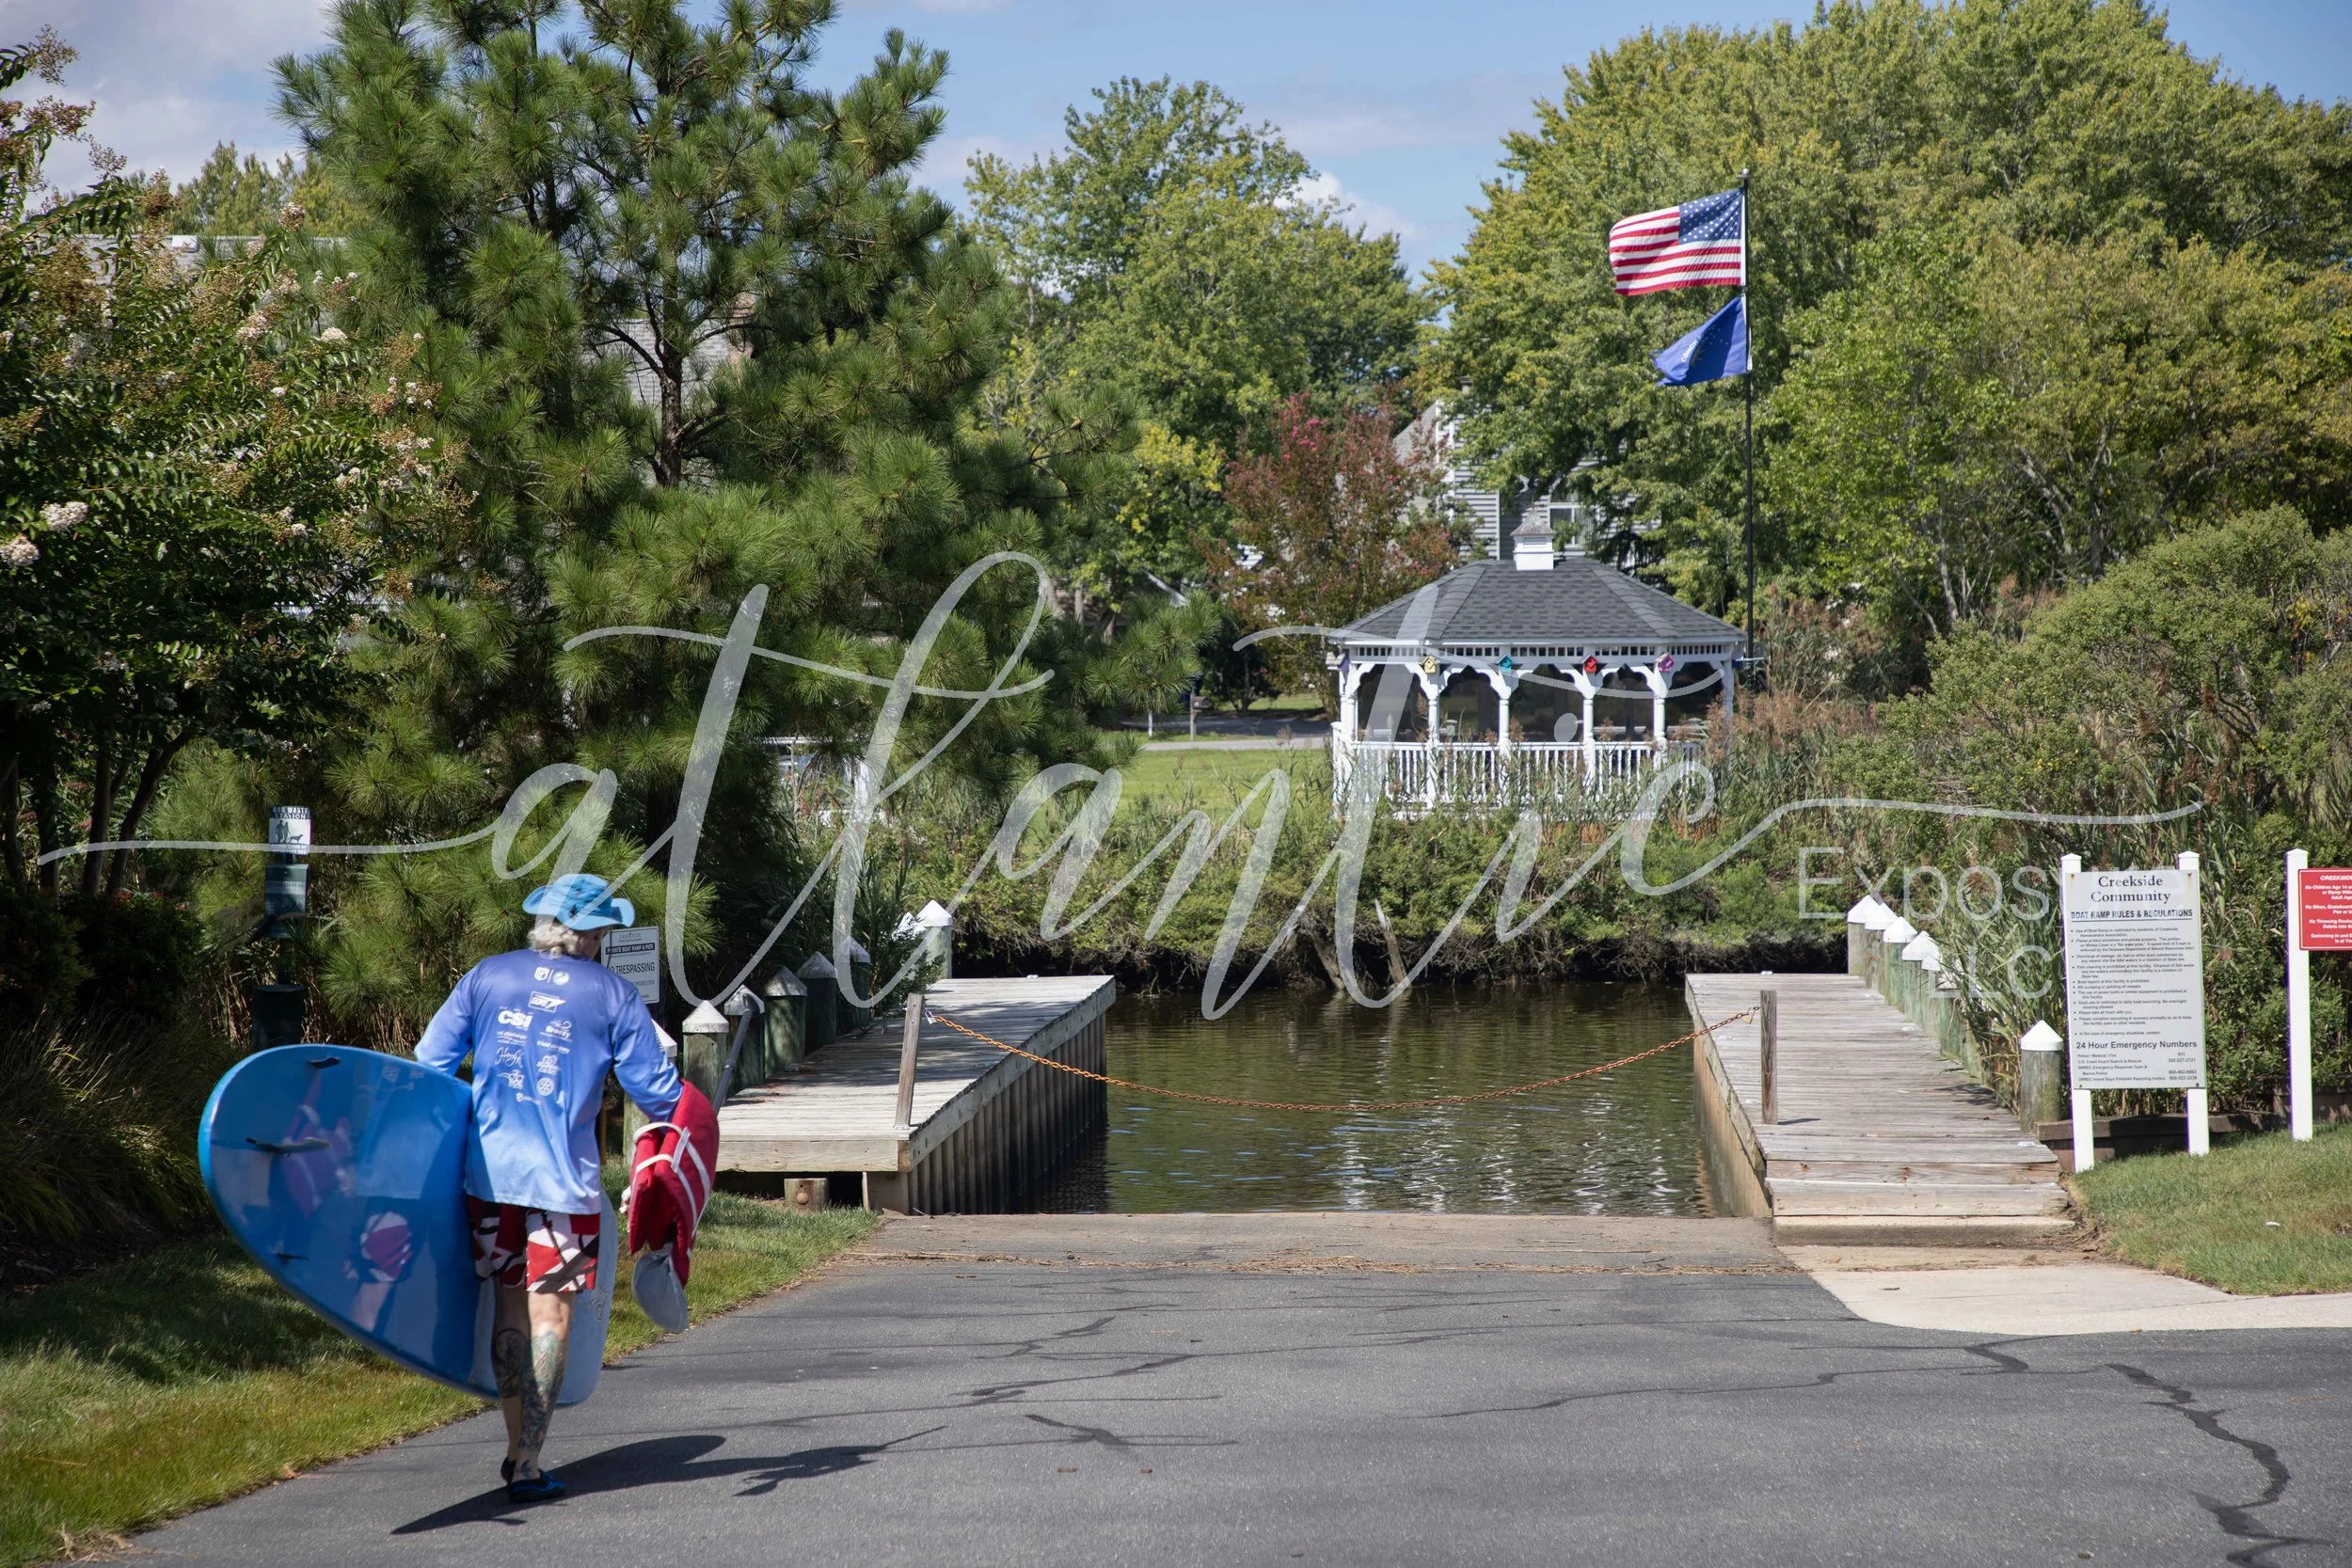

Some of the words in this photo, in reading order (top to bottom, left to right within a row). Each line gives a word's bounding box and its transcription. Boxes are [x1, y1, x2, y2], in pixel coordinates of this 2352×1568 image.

[2098, 875, 2163, 887] Creekside
[2091, 890, 2170, 904] Community
[2112, 910, 2135, 918] RULES
[2144, 909, 2193, 917] REGULATIONS
[616, 961, 655, 975] TRESPASSING
[498, 1009, 532, 1029] CSI
[2110, 1040, 2157, 1050] Emergency
